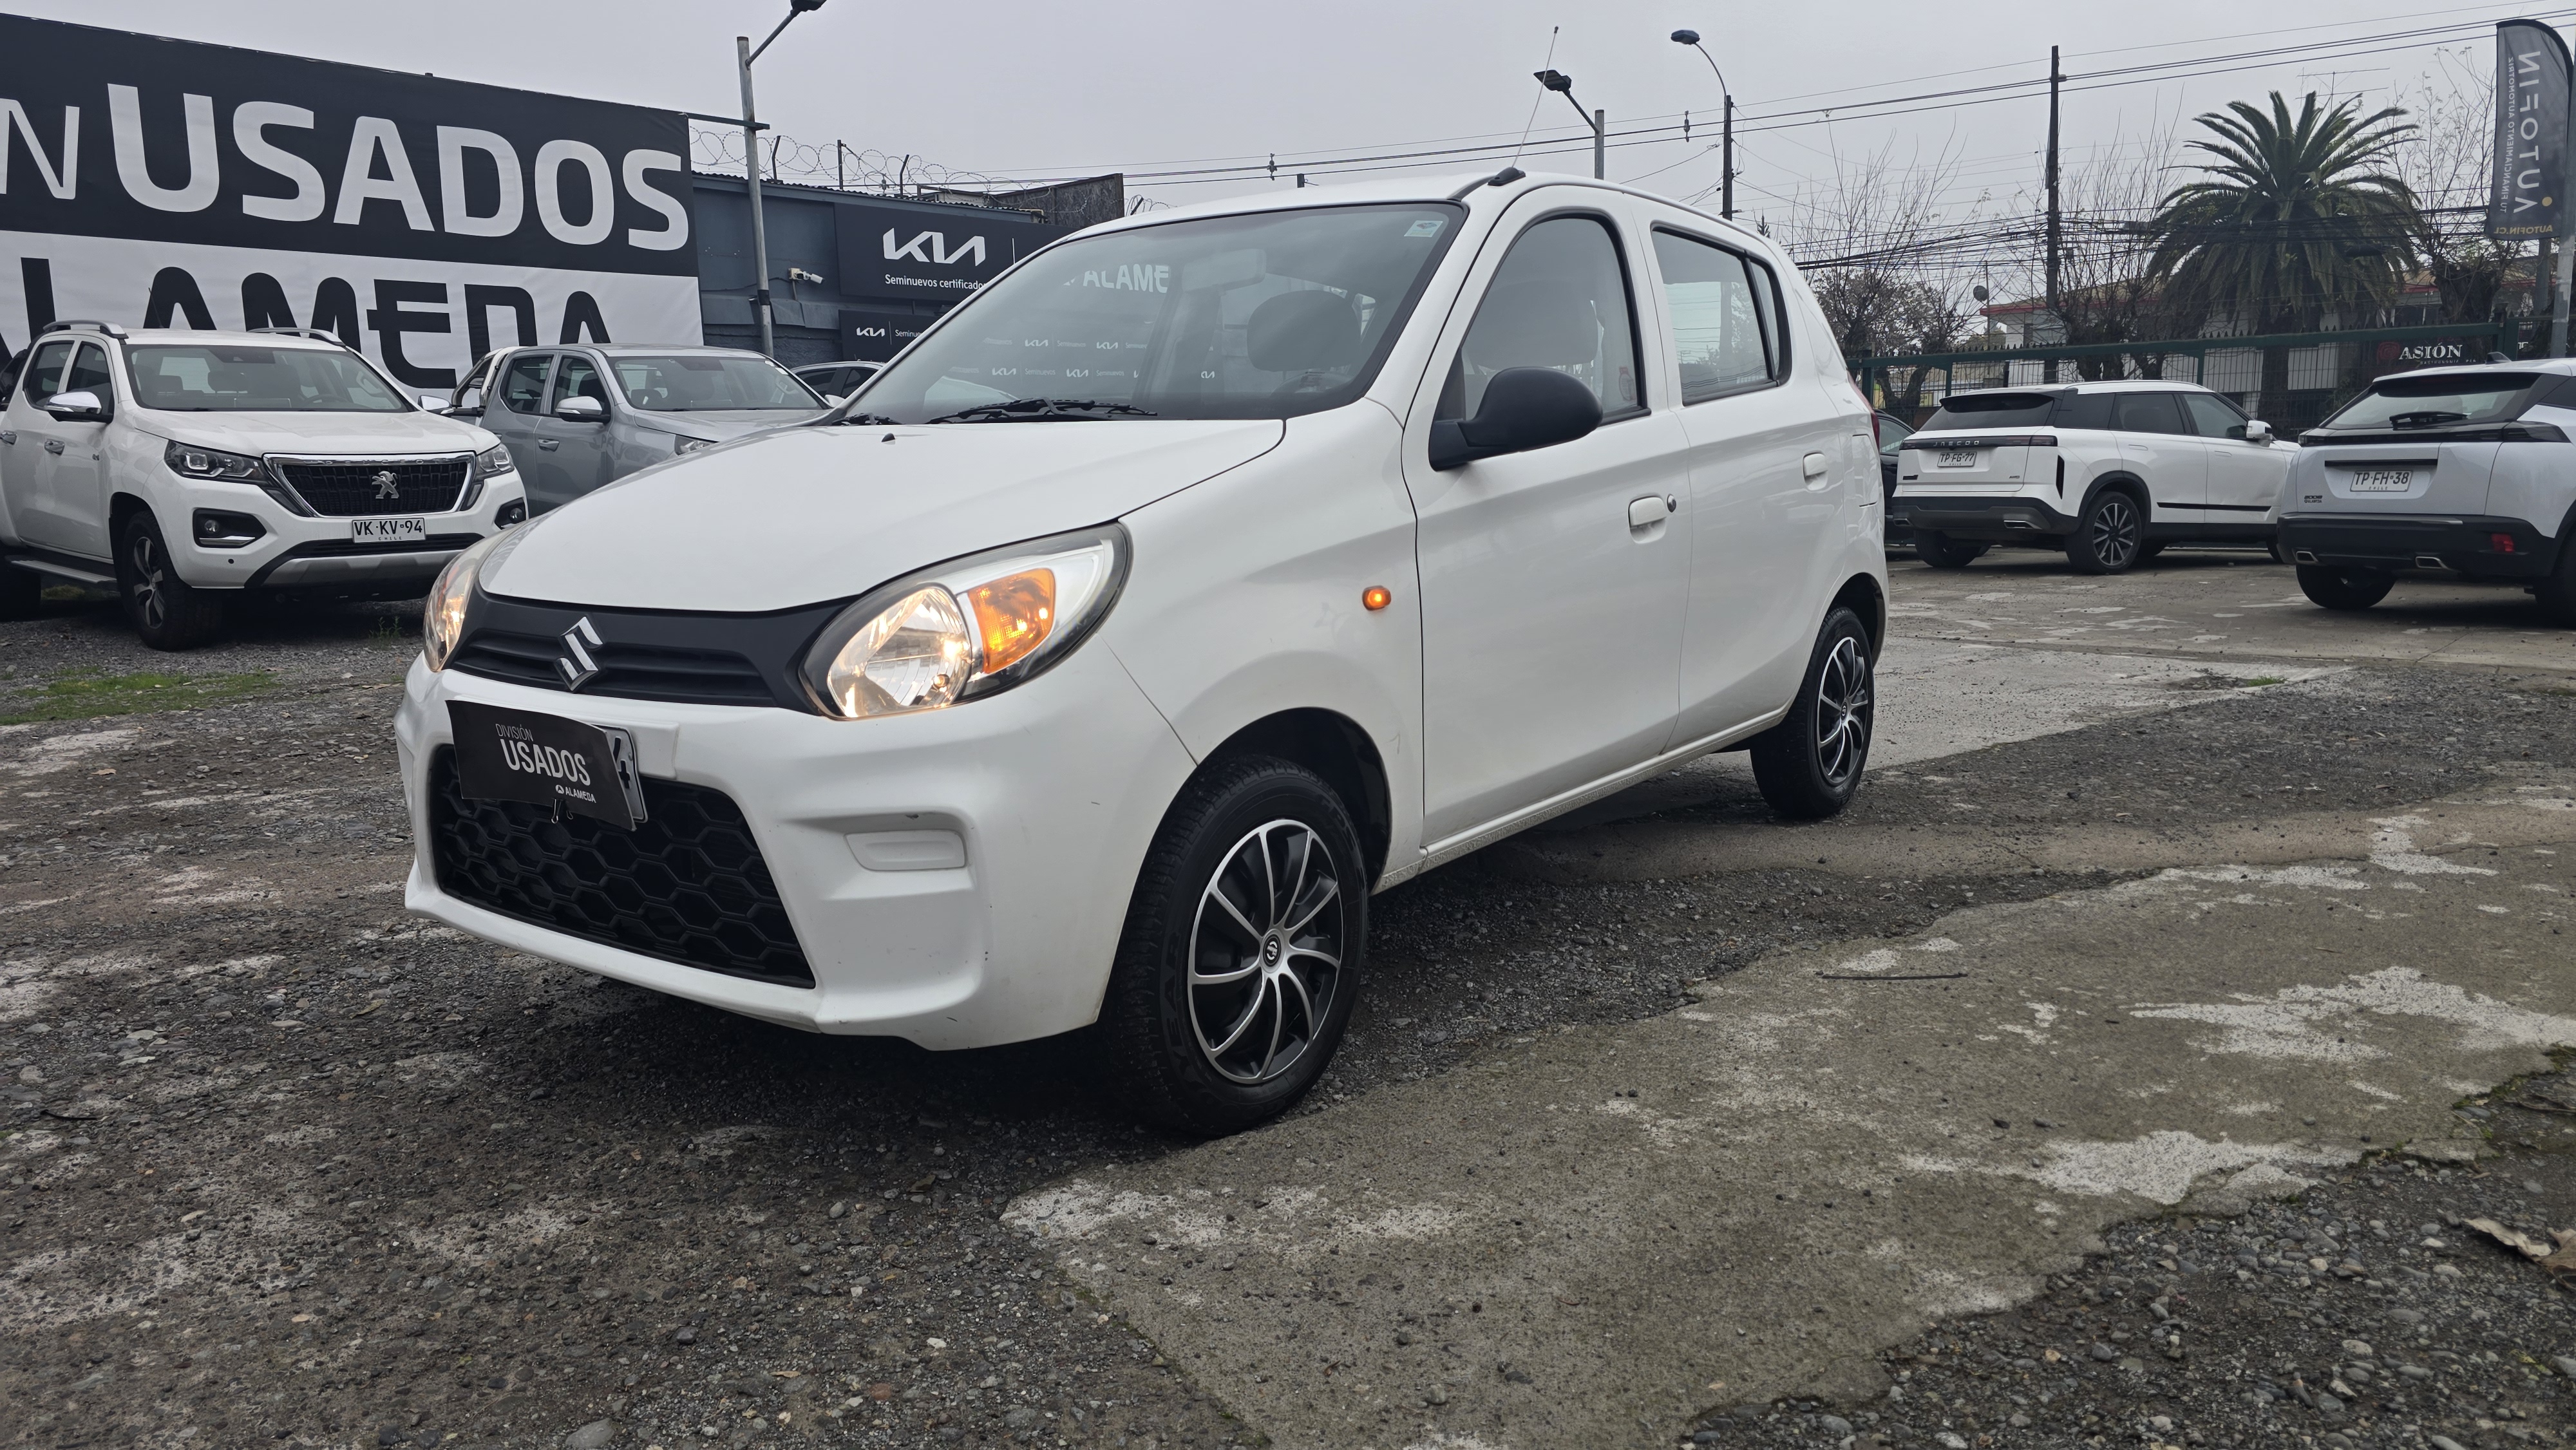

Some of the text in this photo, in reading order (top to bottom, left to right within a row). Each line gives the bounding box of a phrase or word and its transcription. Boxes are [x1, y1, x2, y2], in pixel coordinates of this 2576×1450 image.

[108, 83, 689, 251] USADOS
[885, 274, 987, 290] Seminuevos certificado
[495, 724, 534, 742] DIVISIÓN
[500, 739, 591, 786] USADOS
[565, 787, 596, 804] ALAMEDA
